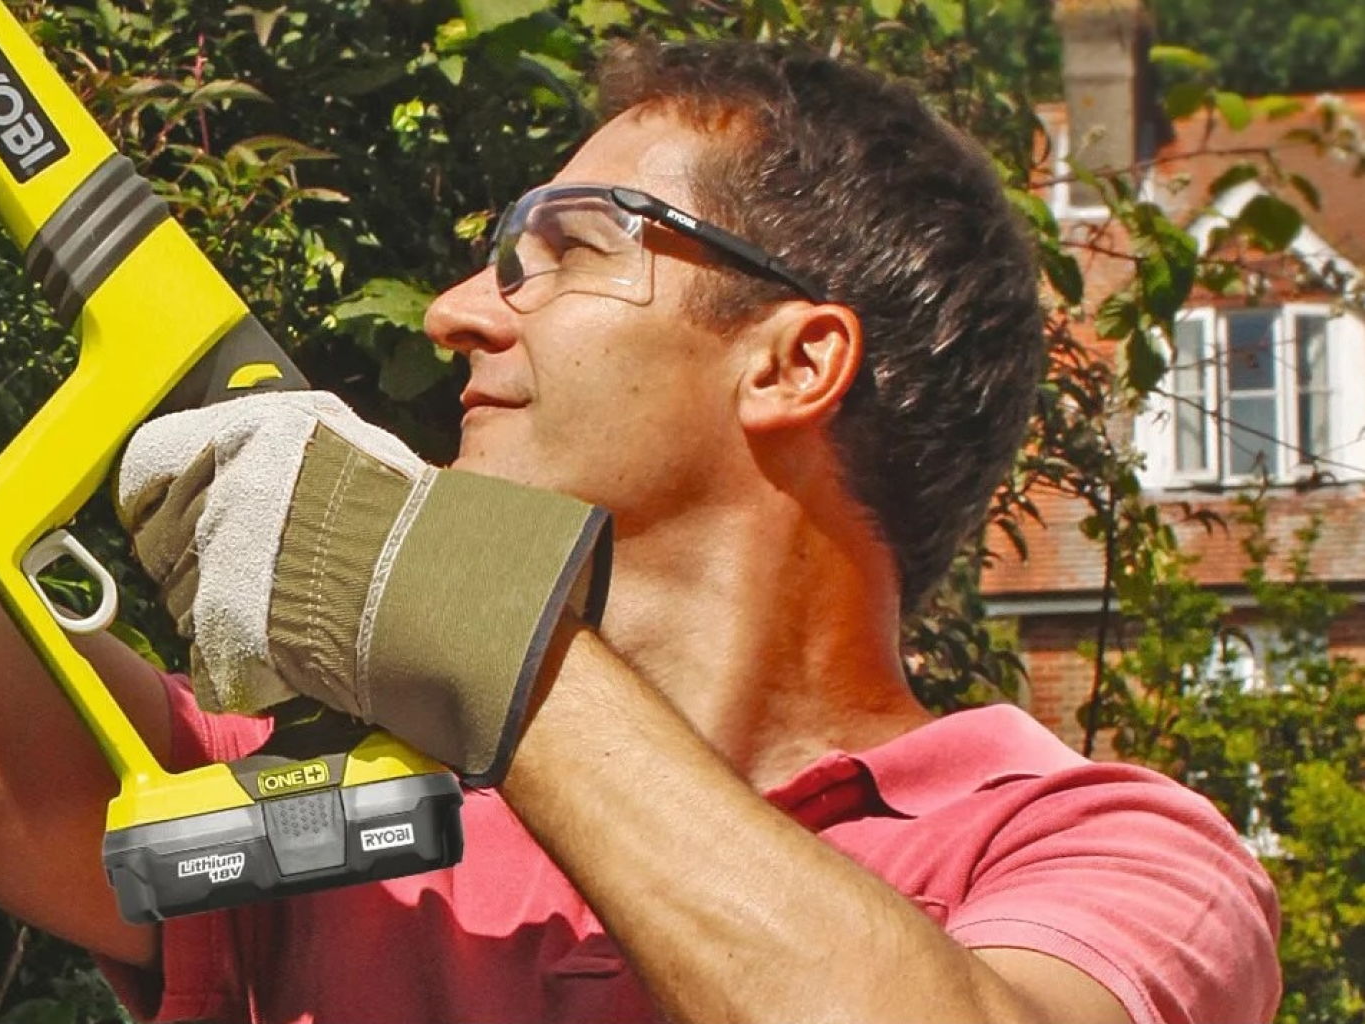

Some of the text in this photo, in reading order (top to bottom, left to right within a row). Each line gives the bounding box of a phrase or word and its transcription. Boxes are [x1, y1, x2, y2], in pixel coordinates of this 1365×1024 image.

[363, 827, 411, 847] RYOBI
[179, 854, 243, 876] Lithium
[210, 865, 241, 882] 18V
